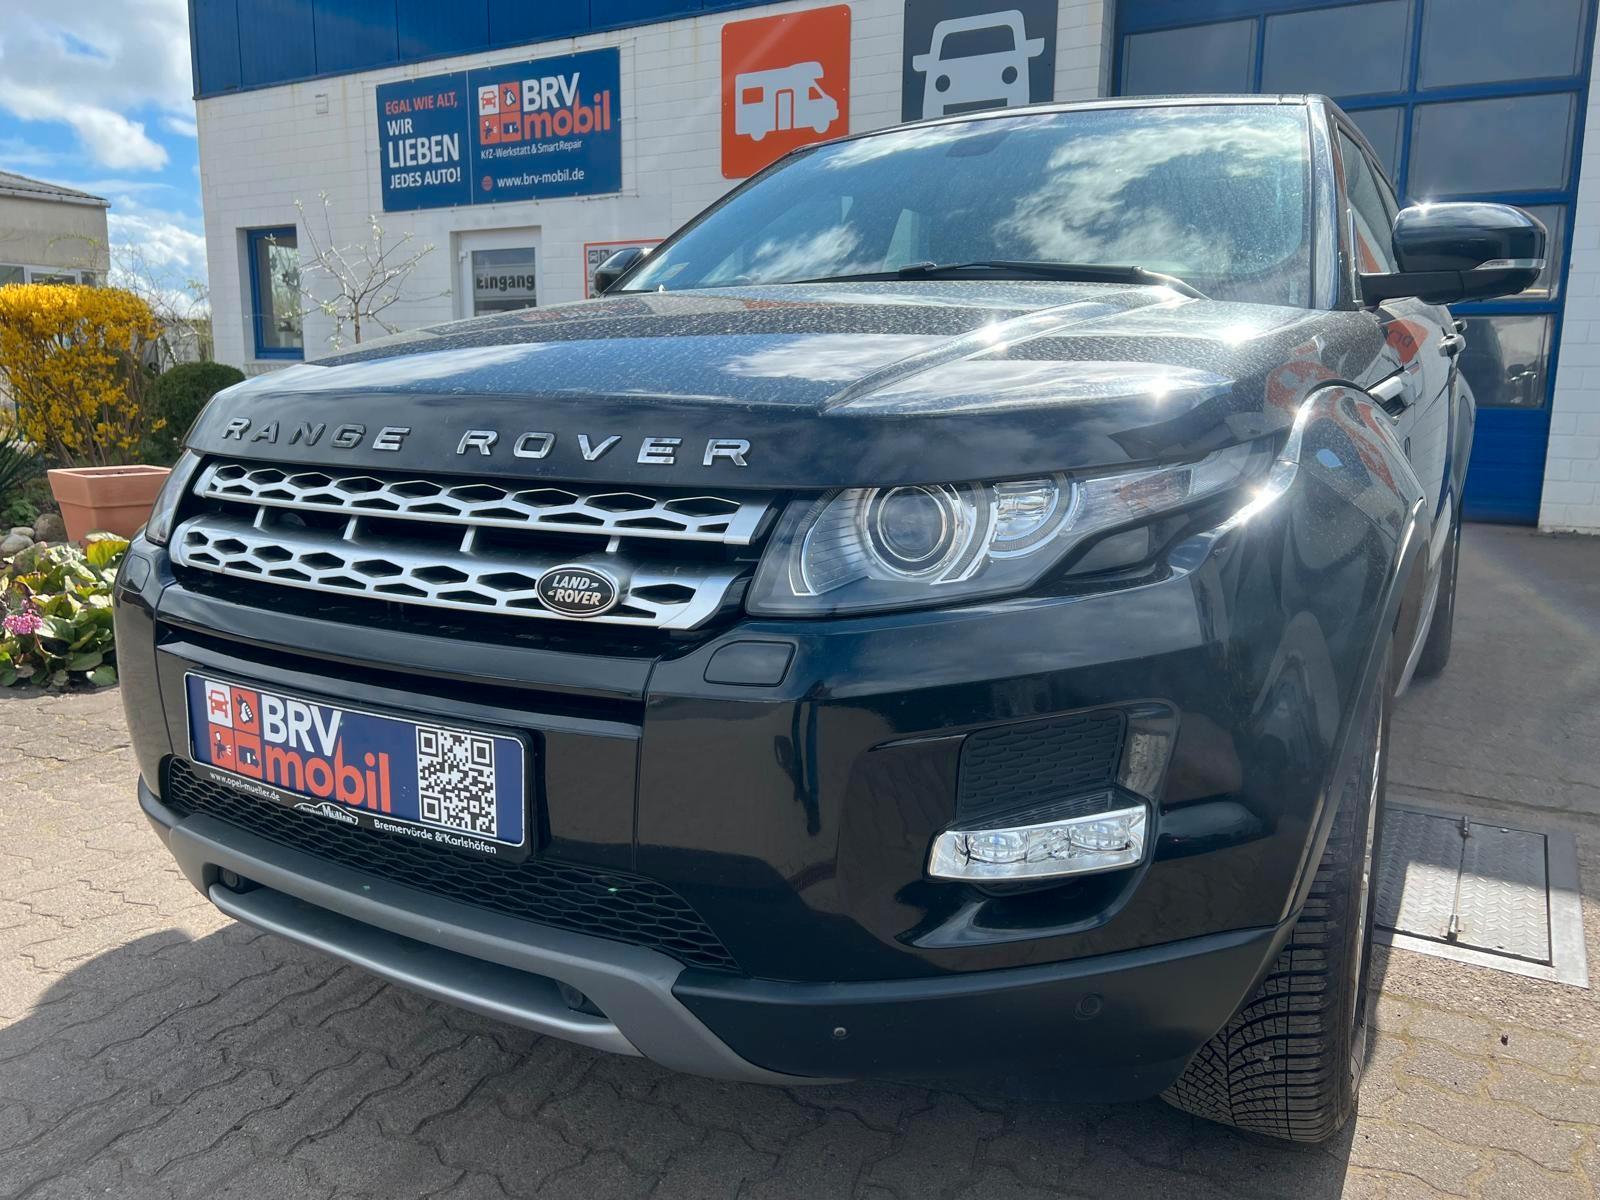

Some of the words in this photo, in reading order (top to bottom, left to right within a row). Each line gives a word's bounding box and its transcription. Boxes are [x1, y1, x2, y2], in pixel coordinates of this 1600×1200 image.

[385, 99, 412, 115] EGAL
[413, 95, 434, 111] WIE
[436, 91, 458, 109] ALT,
[522, 72, 580, 112] BRV
[386, 118, 413, 136] WIR
[524, 89, 611, 139] mobil
[388, 132, 459, 168] LIEBEN
[531, 143, 537, 154] &
[390, 172, 422, 190] JEDES
[423, 167, 461, 186] AUTO!
[497, 167, 585, 188] www.brv-mobil.de
[476, 274, 535, 291] Eingang
[222, 417, 411, 451] RANGE
[456, 429, 750, 467] ROVER
[552, 575, 590, 590] LAND
[554, 588, 602, 606] ROVER
[261, 694, 342, 757] BRV
[209, 772, 280, 801] www.opel-mueller.de
[265, 736, 391, 813] mobil
[374, 819, 432, 840] Bremervörde
[435, 831, 444, 842] &
[444, 833, 497, 854] Karlshöfen
